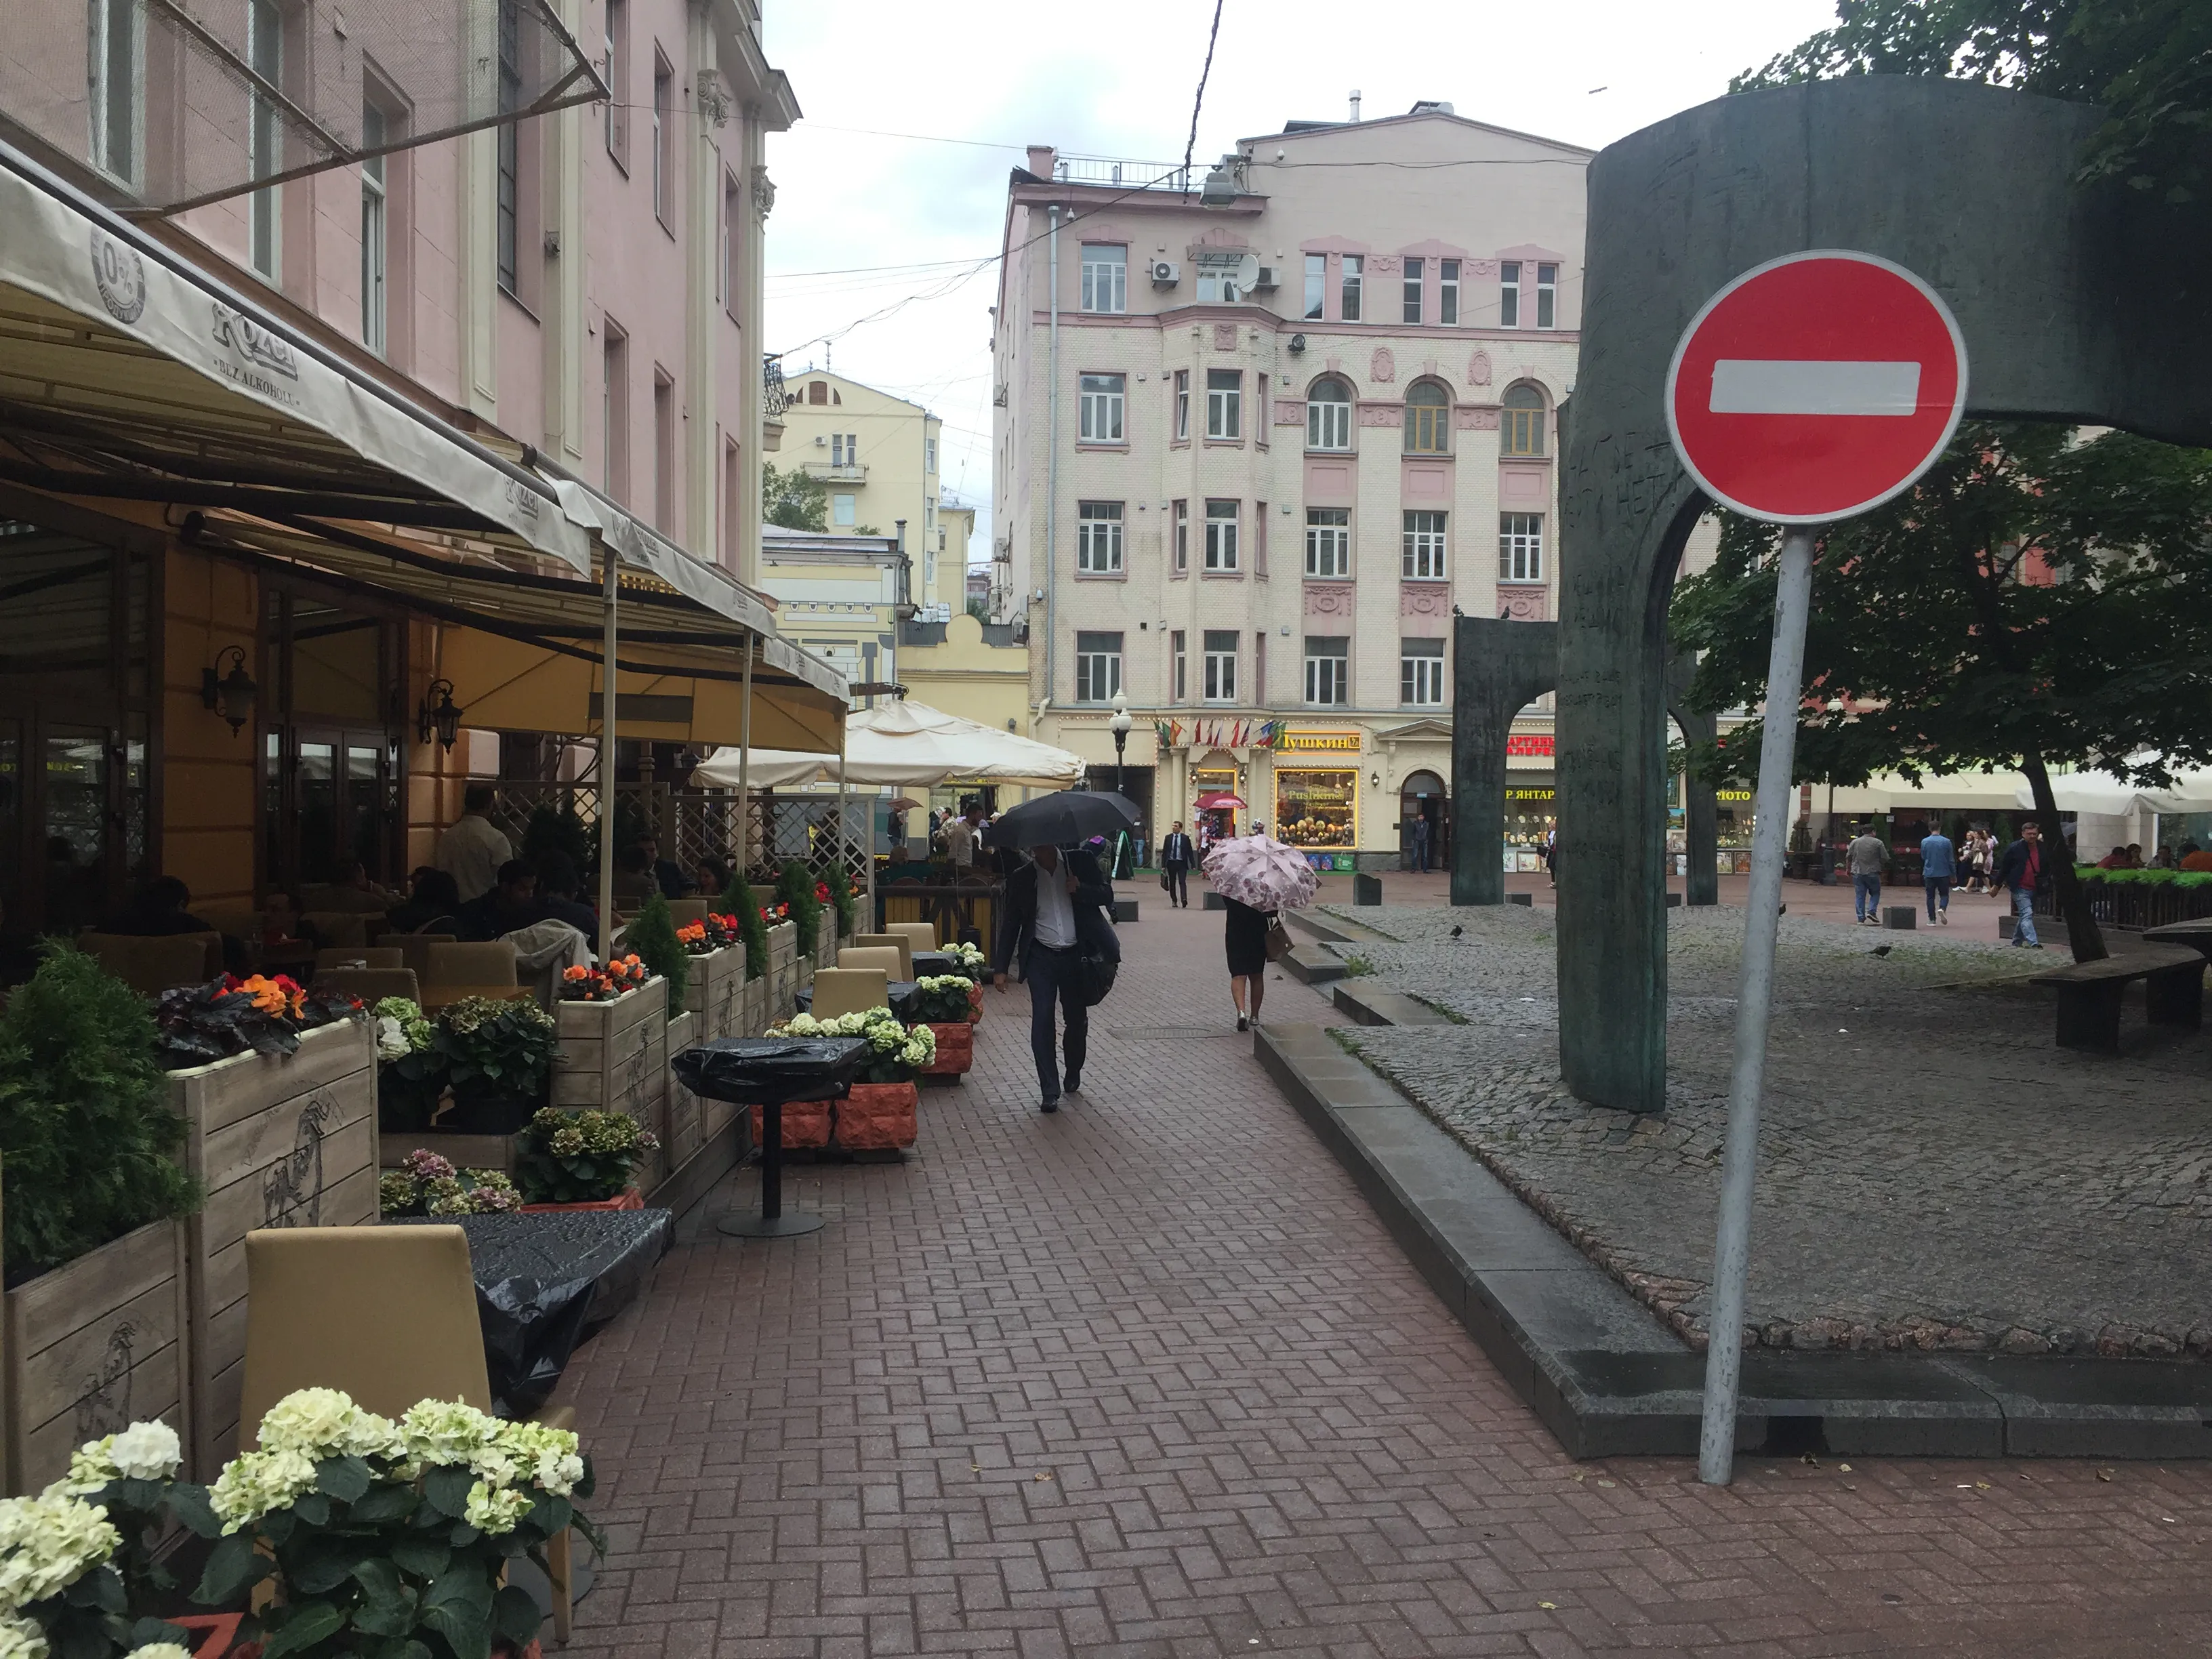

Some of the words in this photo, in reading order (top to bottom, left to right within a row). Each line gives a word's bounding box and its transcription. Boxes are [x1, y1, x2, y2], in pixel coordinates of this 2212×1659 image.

[219, 359, 239, 380] BEZ
[242, 373, 294, 406] ALKOHOLU
[1507, 746, 1555, 756] АЛЕРЕ
[1516, 790, 1555, 800] ЯНТАР
[1717, 791, 1750, 800] ЛОТО
